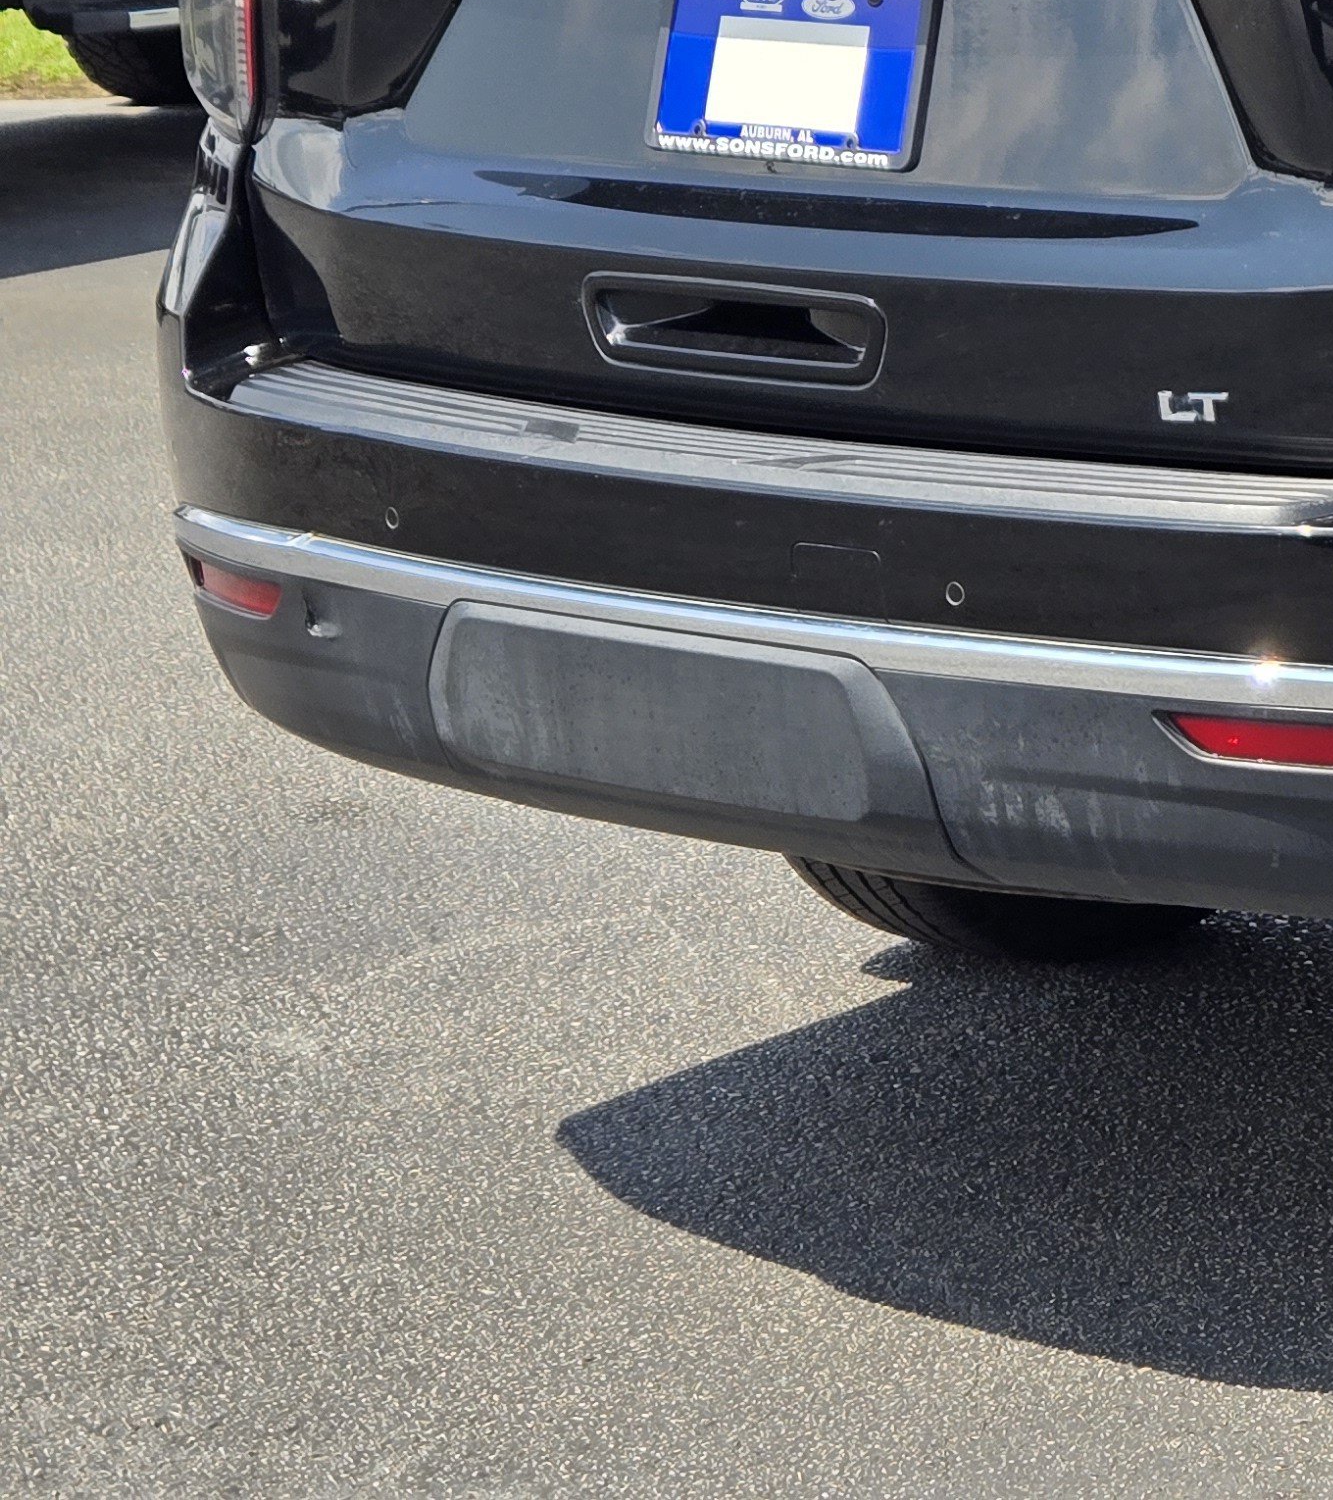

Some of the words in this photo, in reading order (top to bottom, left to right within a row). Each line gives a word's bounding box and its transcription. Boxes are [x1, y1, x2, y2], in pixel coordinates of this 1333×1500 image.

[739, 124, 795, 141] AUBURN,
[798, 129, 814, 143] AL
[658, 134, 889, 167] www.SONSFORD.com
[1157, 390, 1229, 422] LT
